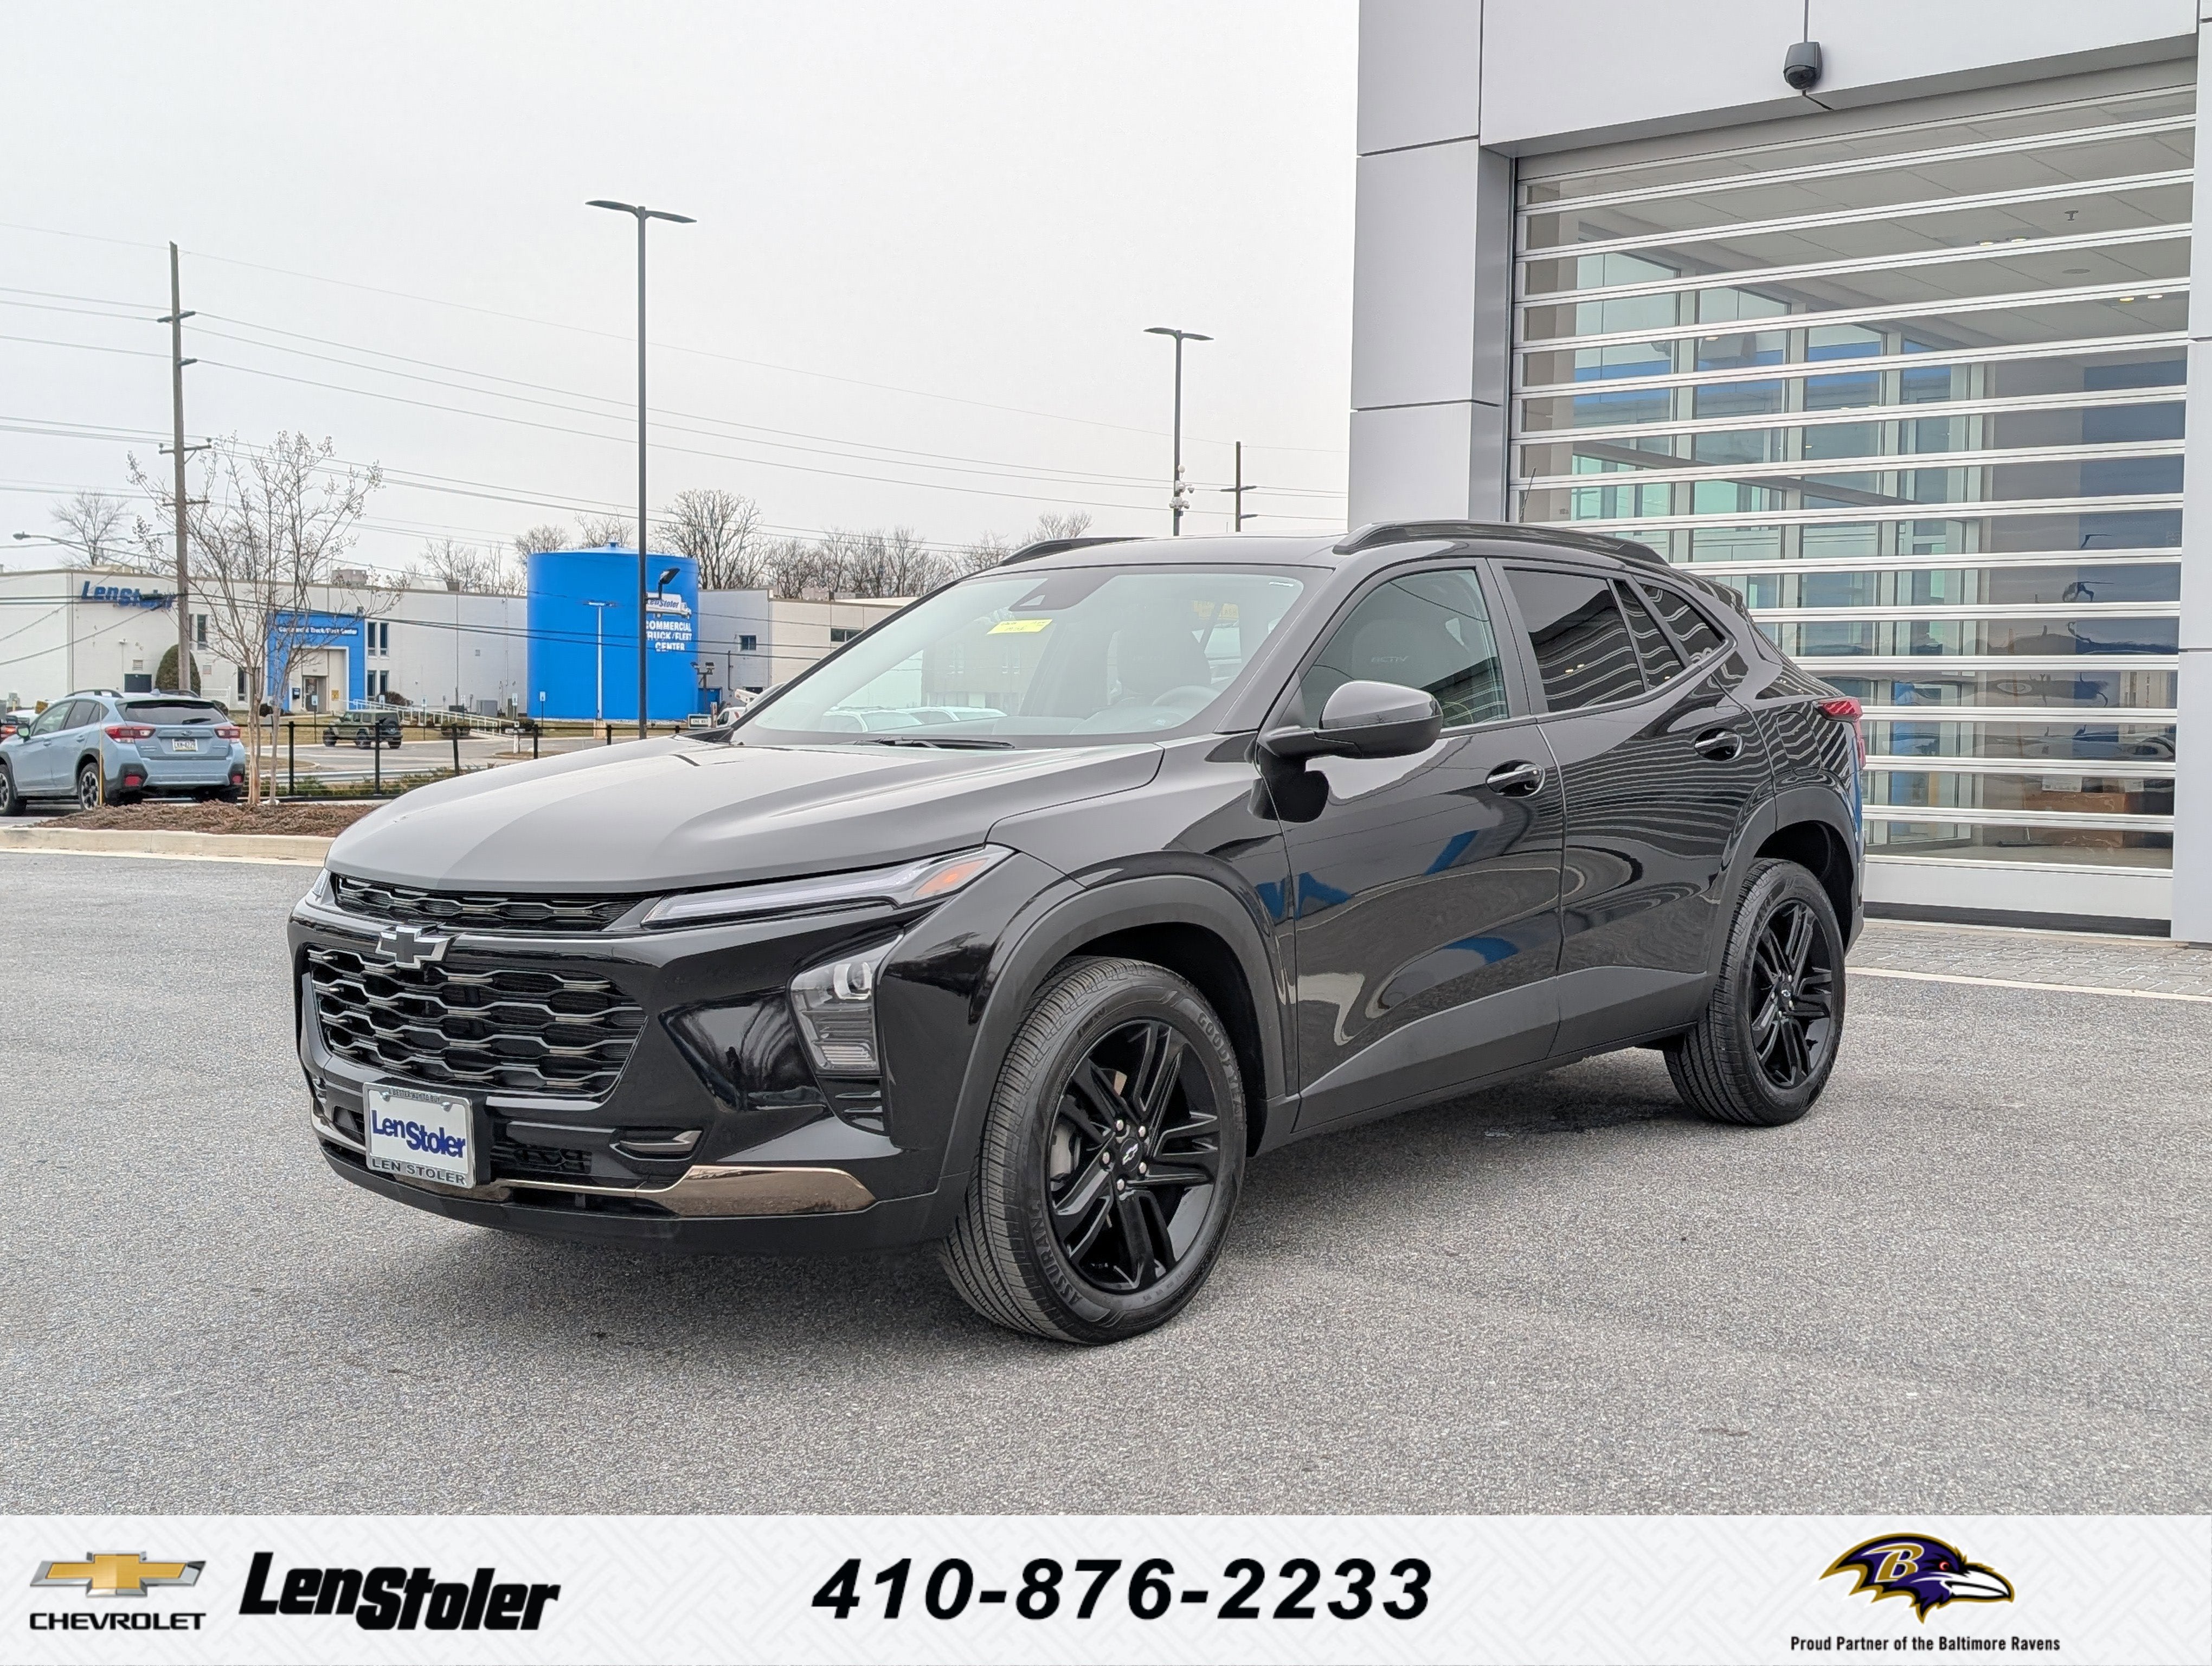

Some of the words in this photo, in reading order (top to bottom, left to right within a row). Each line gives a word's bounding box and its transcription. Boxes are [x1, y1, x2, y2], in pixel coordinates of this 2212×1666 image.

[82, 581, 173, 608] LenStr
[655, 642, 685, 651] CENTER
[371, 1110, 466, 1158] LenStoler
[371, 1158, 401, 1172] LEN
[407, 1164, 467, 1186] STOLER
